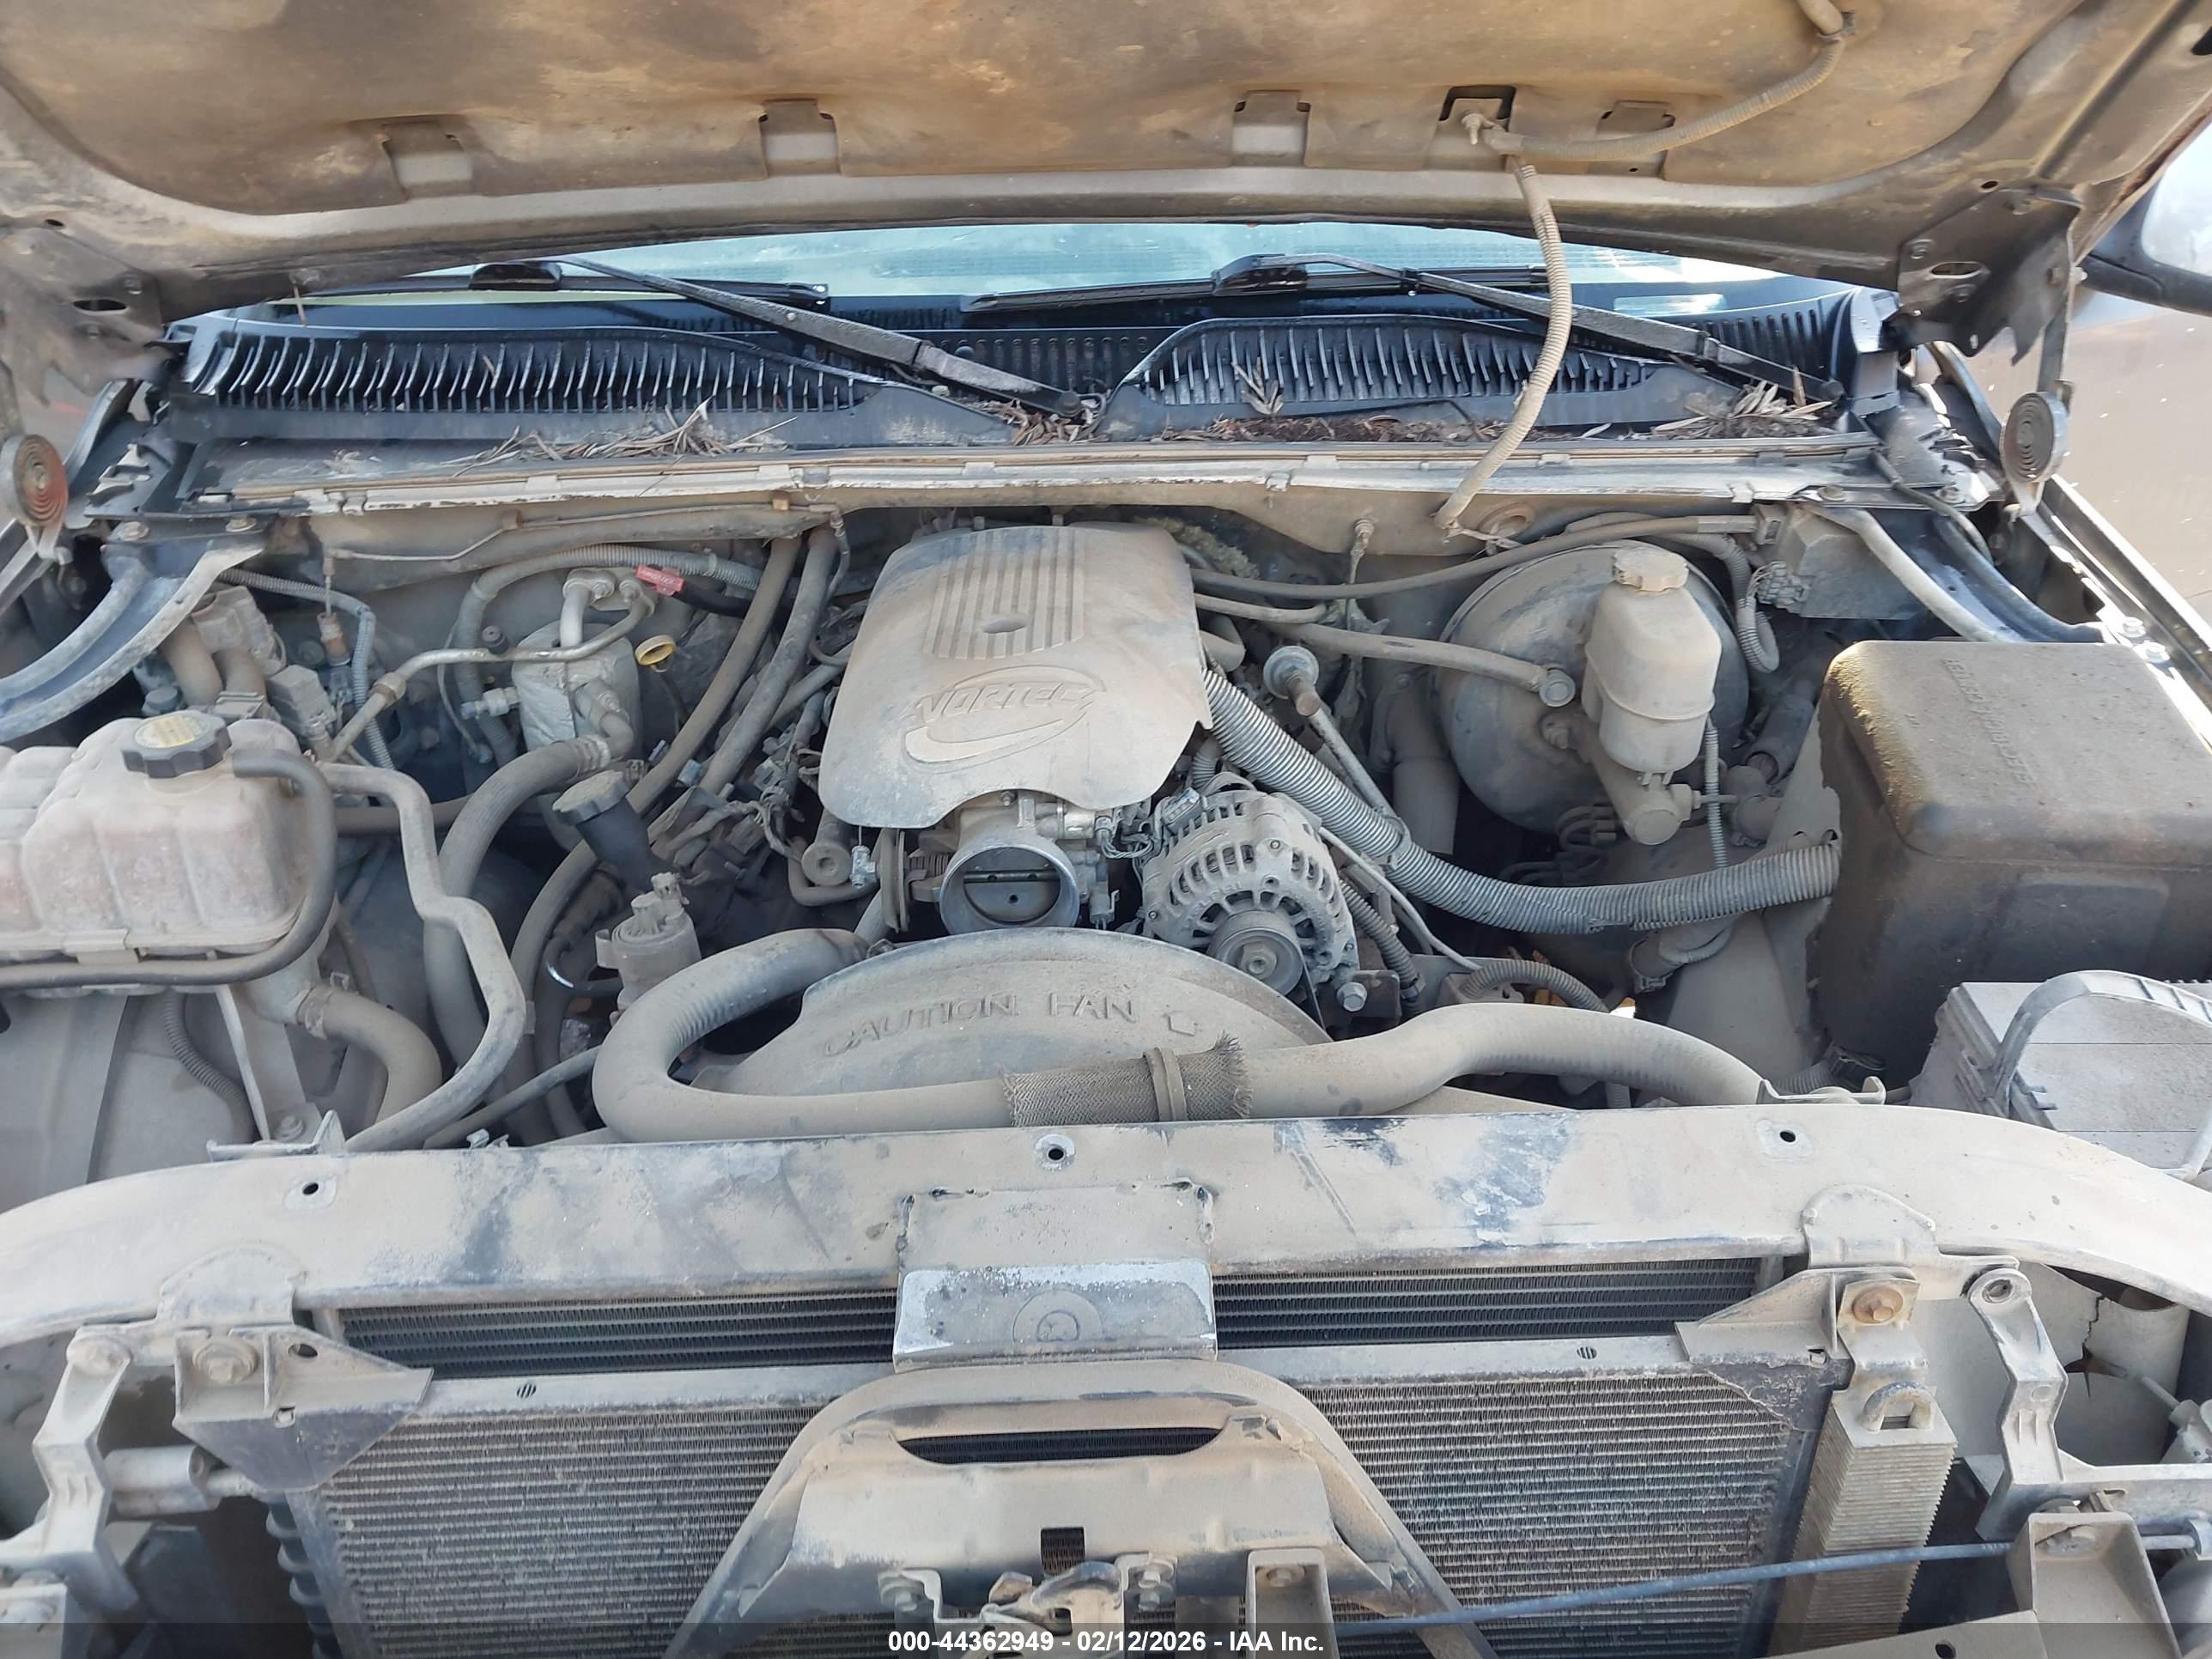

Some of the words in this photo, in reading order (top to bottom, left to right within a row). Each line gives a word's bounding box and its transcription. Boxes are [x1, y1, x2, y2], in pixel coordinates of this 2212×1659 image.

[903, 684, 1097, 724] VORTEC
[822, 991, 1020, 1057] CAUTION
[1048, 991, 1139, 1024] FAN
